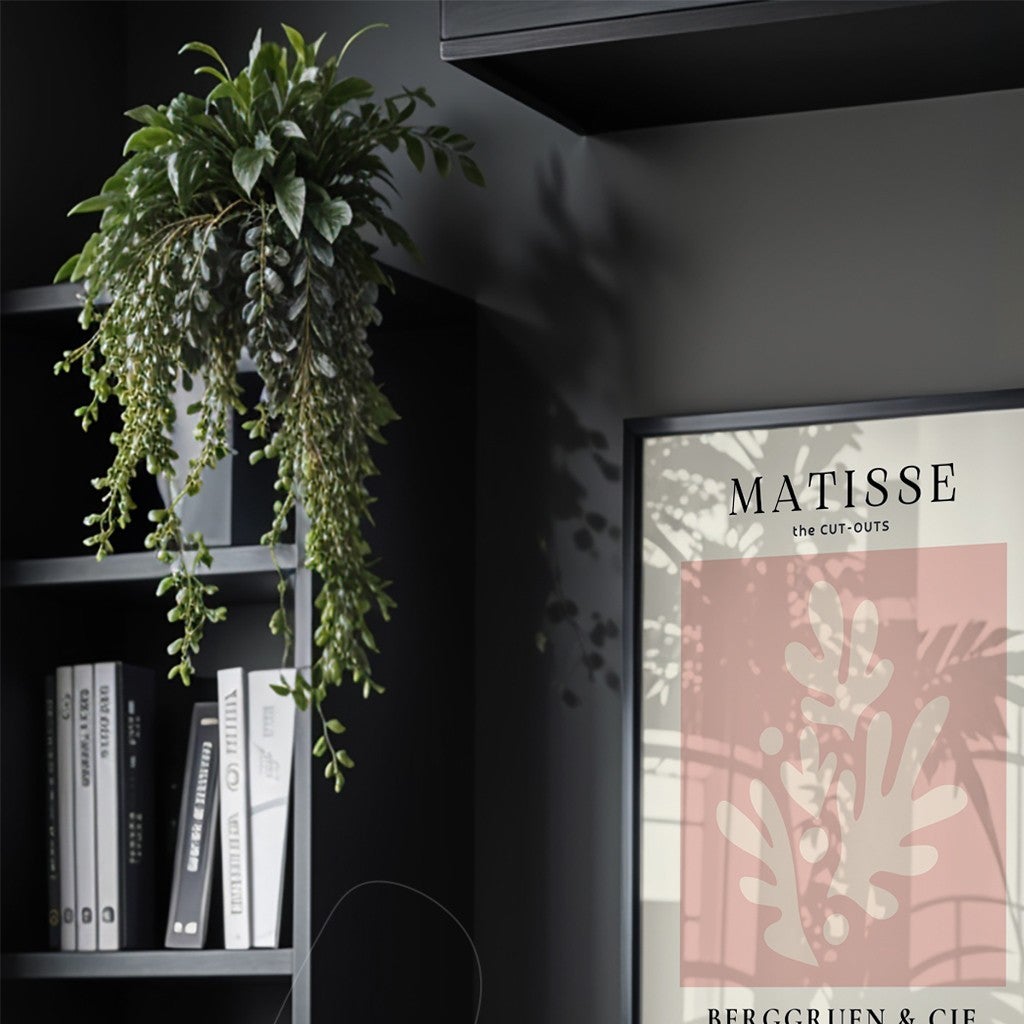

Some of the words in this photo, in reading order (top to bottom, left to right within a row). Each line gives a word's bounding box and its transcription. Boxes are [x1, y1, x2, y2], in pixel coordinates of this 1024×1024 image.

[728, 462, 956, 516] MATISSE
[792, 524, 816, 538] the
[819, 520, 890, 537] CUT-OUTS
